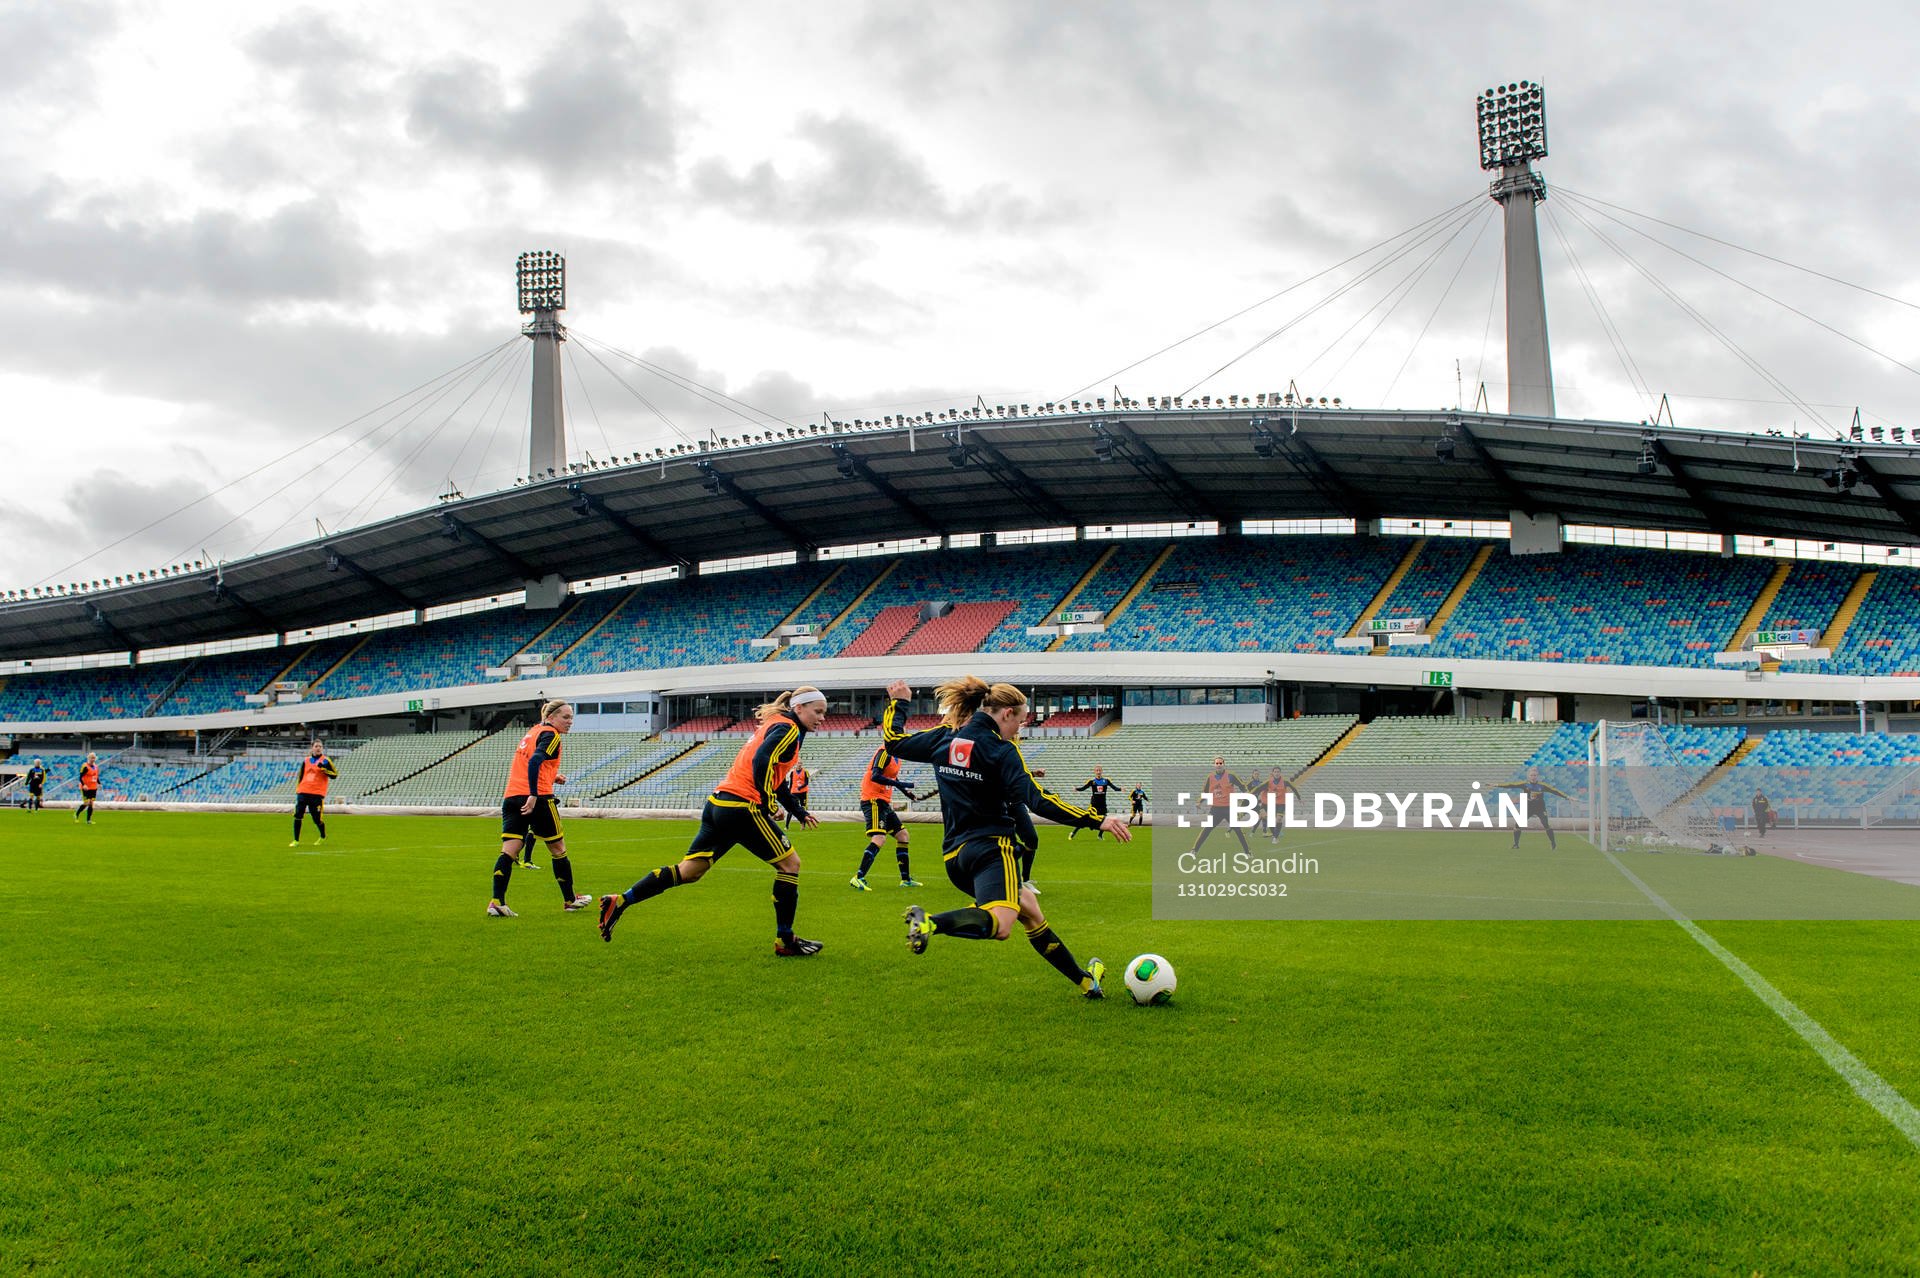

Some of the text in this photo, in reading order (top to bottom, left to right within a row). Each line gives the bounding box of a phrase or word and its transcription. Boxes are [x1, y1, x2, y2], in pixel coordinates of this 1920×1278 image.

[1778, 633, 1791, 641] C2
[939, 766, 984, 781] SVENSKA SPEL
